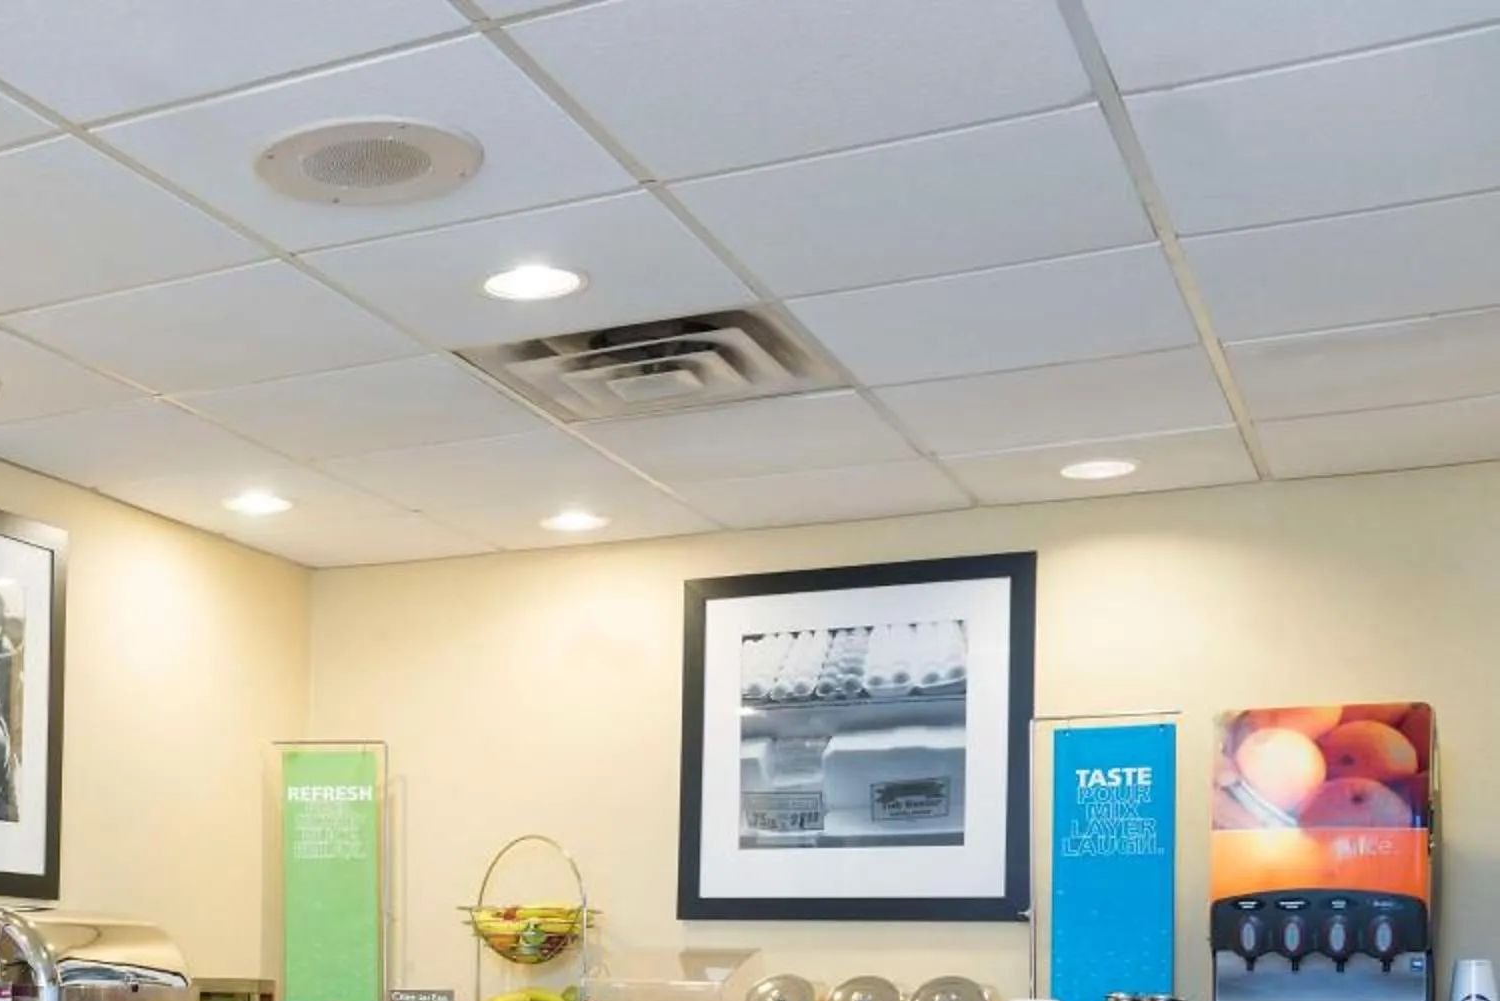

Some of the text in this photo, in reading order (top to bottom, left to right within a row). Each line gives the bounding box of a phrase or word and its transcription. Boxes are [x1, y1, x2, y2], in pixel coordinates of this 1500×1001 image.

[1075, 767, 1153, 788] TASTE
[287, 785, 373, 801] REFRESH
[1077, 785, 1153, 805] POUR
[1085, 801, 1141, 822] MIX
[1071, 818, 1158, 840] LAYER
